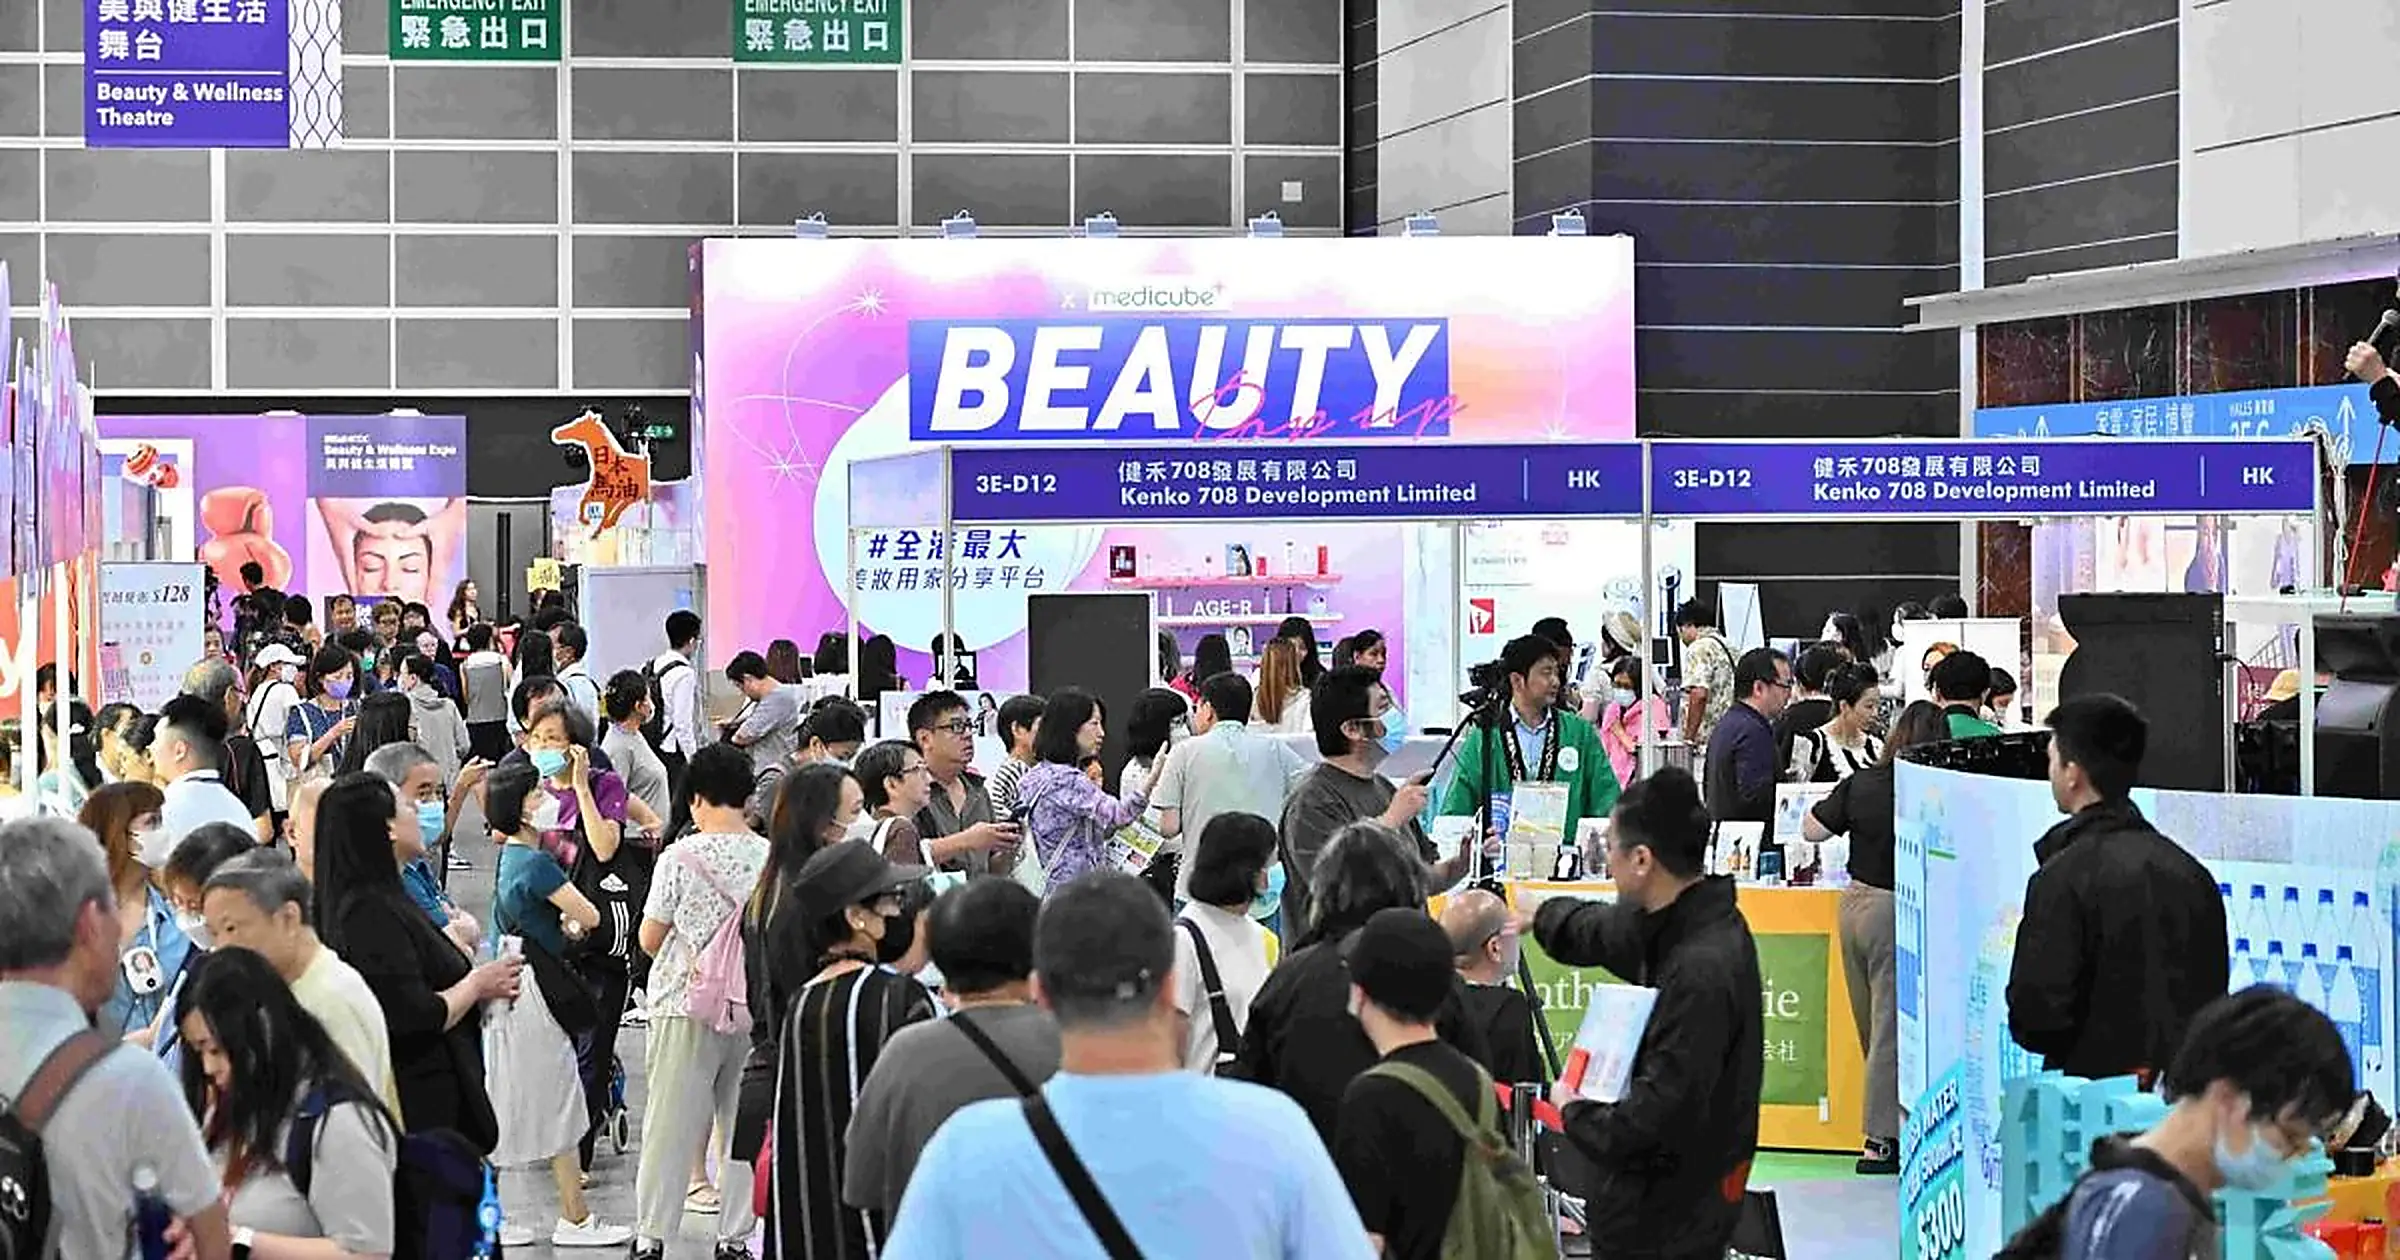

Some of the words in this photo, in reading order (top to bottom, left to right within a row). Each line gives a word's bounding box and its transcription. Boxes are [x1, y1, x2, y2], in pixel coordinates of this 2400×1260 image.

[98, 0, 267, 22] 美與健生活
[401, 0, 503, 10] EMERGENCY
[512, 0, 545, 10] EXIT
[745, 0, 846, 13] EMERGENCY
[854, 0, 886, 13] EXIT
[401, 15, 547, 49] 緊急出口
[745, 18, 889, 51] 緊急出口
[98, 30, 163, 60] 舞台
[97, 83, 168, 105] Beauty
[173, 84, 189, 101] &
[193, 82, 284, 101] Wellness
[97, 107, 174, 126] Theatre
[929, 325, 1440, 432] BEAUTY
[1119, 460, 1358, 483] 健禾708發展有限公司
[1814, 456, 2041, 478] 健禾708發展有限公司
[2243, 467, 2274, 485] HK
[976, 475, 1057, 493] 3E-D12
[1568, 470, 1600, 488] HK
[1674, 469, 1751, 488] 3E-D12
[1121, 486, 1190, 506] Kenko
[1198, 486, 1238, 504] 708
[1245, 485, 1389, 508] Development
[1397, 483, 1476, 503] Limited
[1814, 482, 1881, 501] Kenko
[1888, 482, 1927, 500] 708
[1934, 480, 2072, 502] Development
[2079, 479, 2155, 498] Limited
[1193, 600, 1252, 616] AGE-R
